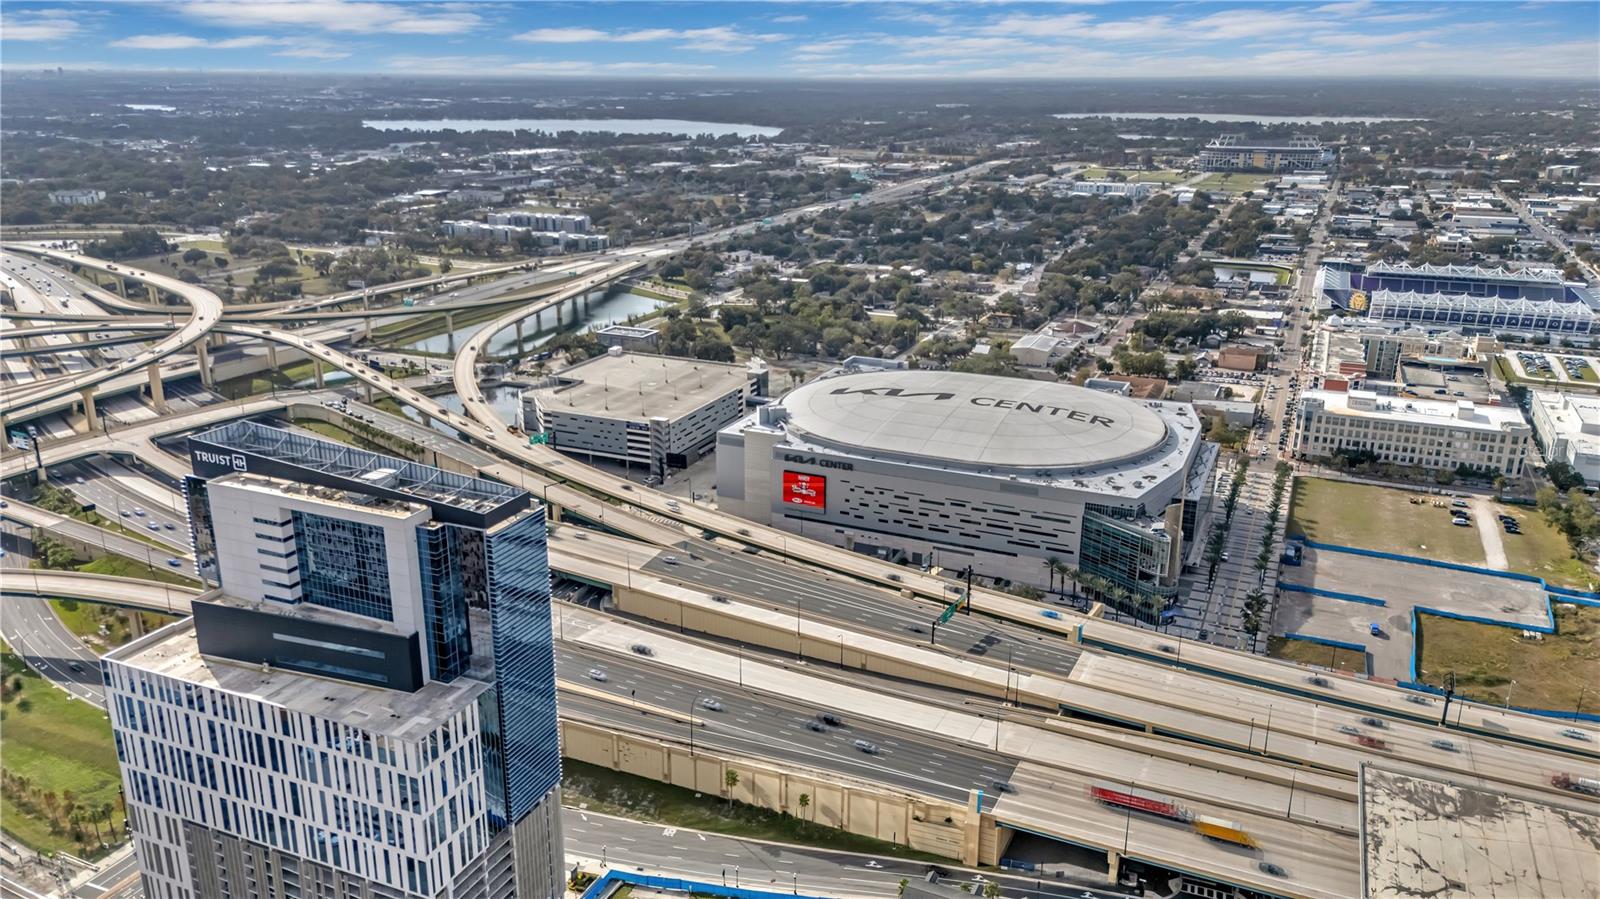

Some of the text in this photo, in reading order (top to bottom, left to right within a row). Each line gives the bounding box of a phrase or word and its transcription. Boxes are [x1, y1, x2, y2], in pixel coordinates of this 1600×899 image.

[970, 397, 1116, 428] CENTER
[194, 450, 231, 466] TRUIST
[819, 459, 854, 471] CENTER
